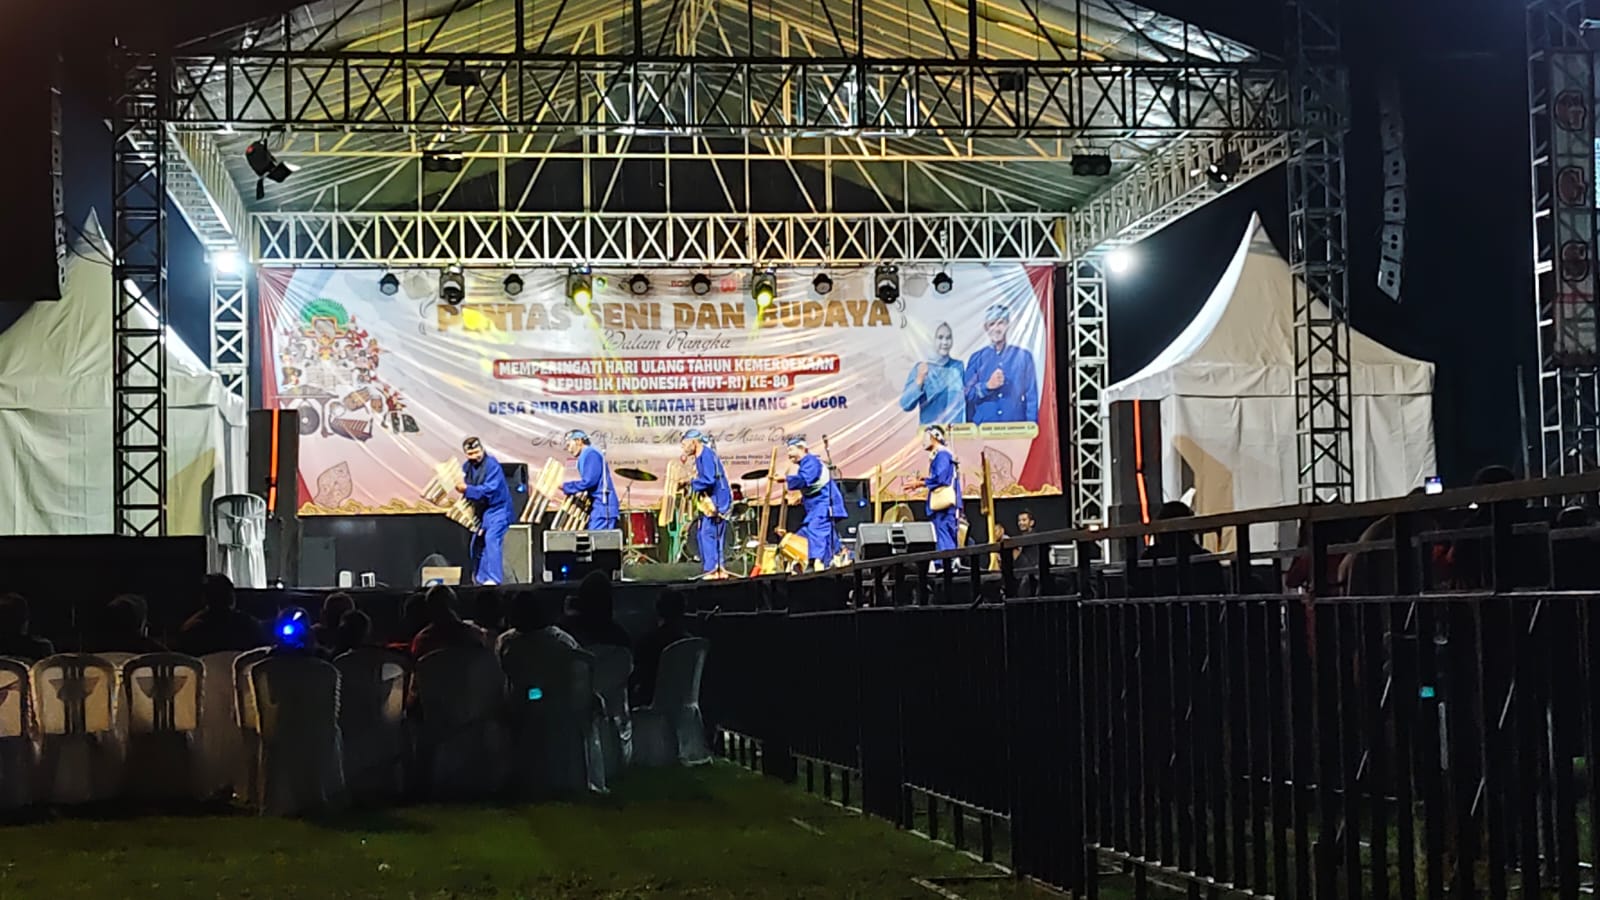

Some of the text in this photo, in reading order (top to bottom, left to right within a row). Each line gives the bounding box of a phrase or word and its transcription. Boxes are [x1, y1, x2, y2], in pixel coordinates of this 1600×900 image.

[437, 303, 572, 331] PNTAS
[674, 302, 745, 330] DAN
[603, 329, 732, 351] Dalam Rangka
[499, 358, 834, 375] MEMPERINGATI HARI ULANG TAHUN KEMERDEKAAN
[547, 374, 789, 391] REPUBLIK INDONESIA (HUT-RI) KE-80
[489, 401, 526, 415] DESA
[608, 399, 695, 413] KECAMATAN
[700, 398, 787, 412] LEUWILIANG
[801, 396, 848, 410] BOGOR
[635, 414, 706, 428] TAHUN 2025
